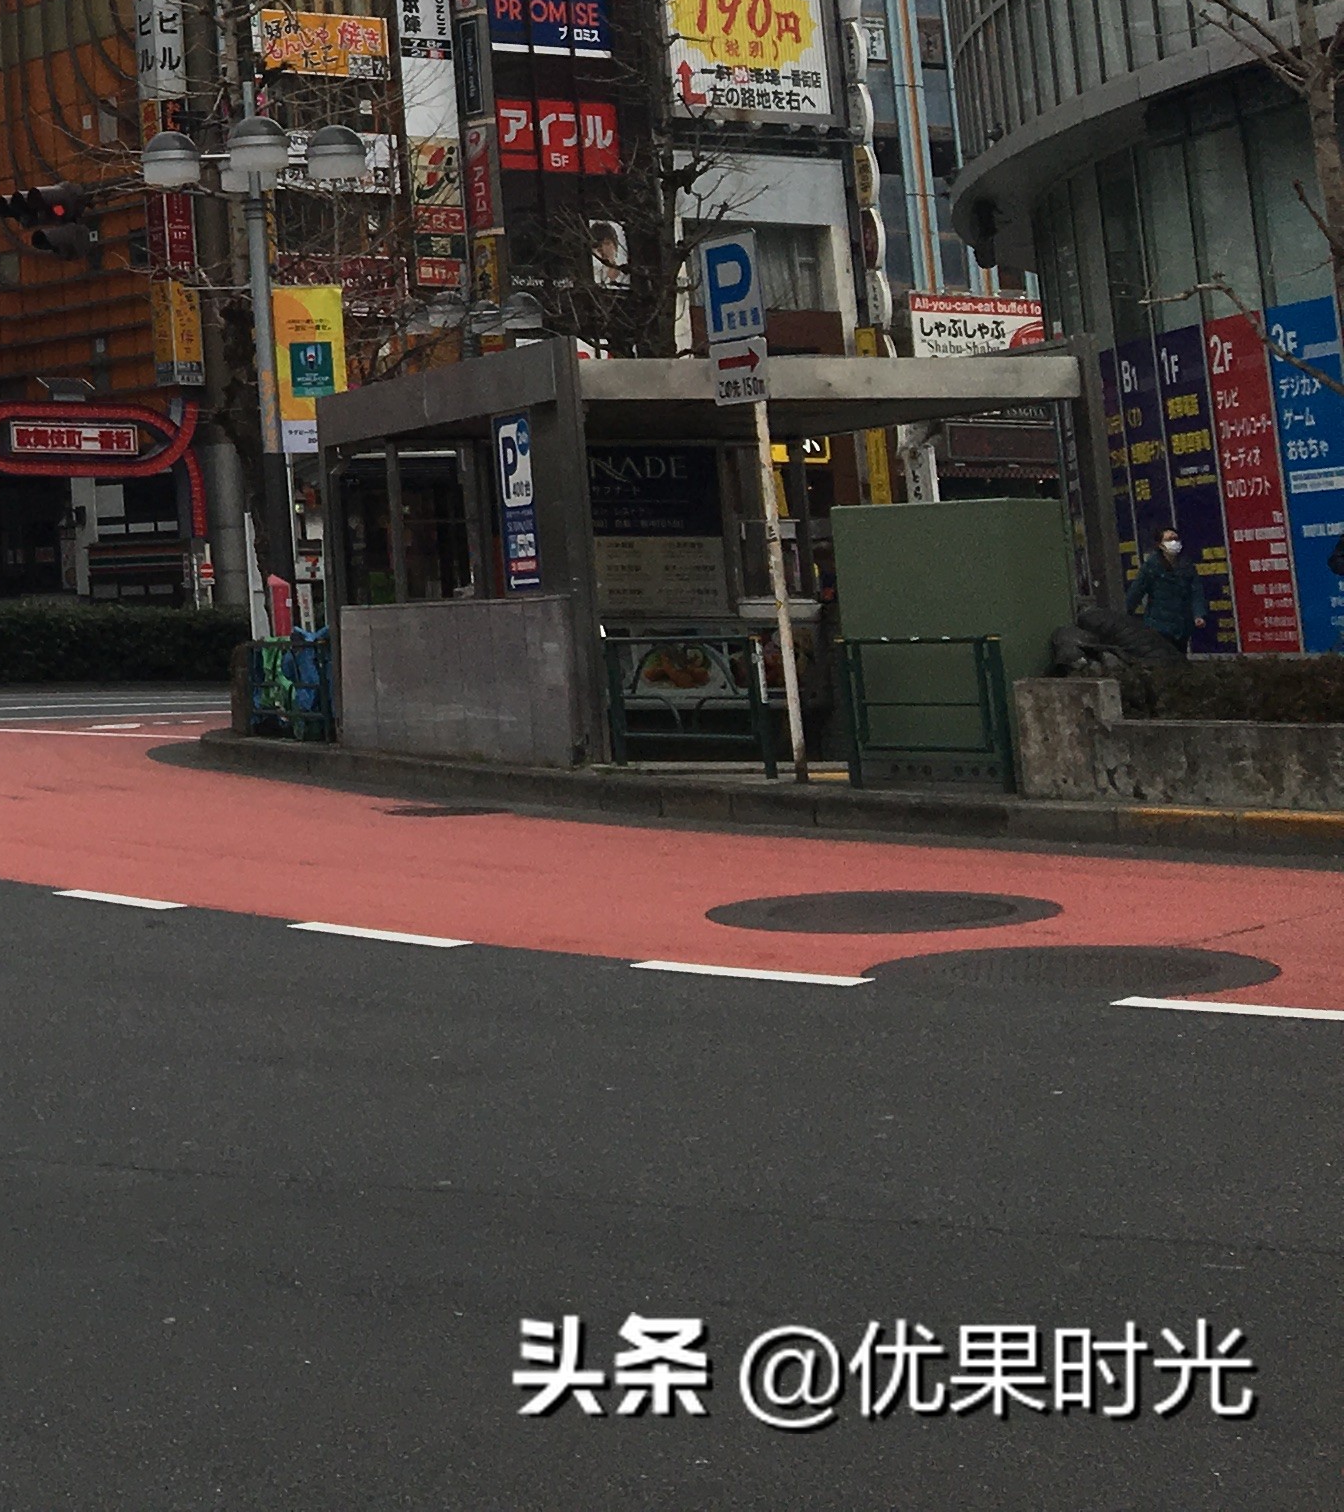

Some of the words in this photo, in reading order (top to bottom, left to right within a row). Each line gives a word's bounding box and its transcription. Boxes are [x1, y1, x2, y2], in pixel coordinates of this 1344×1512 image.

[265, 26, 330, 60] もんじゃ
[337, 20, 381, 52] 焼き
[558, 26, 601, 43] プロミス
[303, 45, 339, 69] たこ
[711, 87, 817, 111] 左の路地を右へ
[499, 108, 613, 149] アイフル
[550, 152, 570, 167] 5F
[473, 166, 488, 212] アコム
[705, 243, 753, 333] P
[915, 297, 995, 313] All-you-can-eat
[997, 300, 1028, 315] buffet
[1030, 302, 1042, 314] fo
[919, 316, 1007, 340] しゃぶしゃぶ
[1161, 347, 1179, 385] 1F
[1210, 334, 1233, 375] 2F
[1121, 360, 1138, 393] B1
[1216, 388, 1240, 410] テレビ
[1283, 406, 1316, 430] ゲーム
[15, 428, 133, 449] 歌舞伎町一番街
[1286, 438, 1330, 461] おもちゃ
[501, 436, 519, 500] P
[1222, 445, 1261, 470] オーディオ
